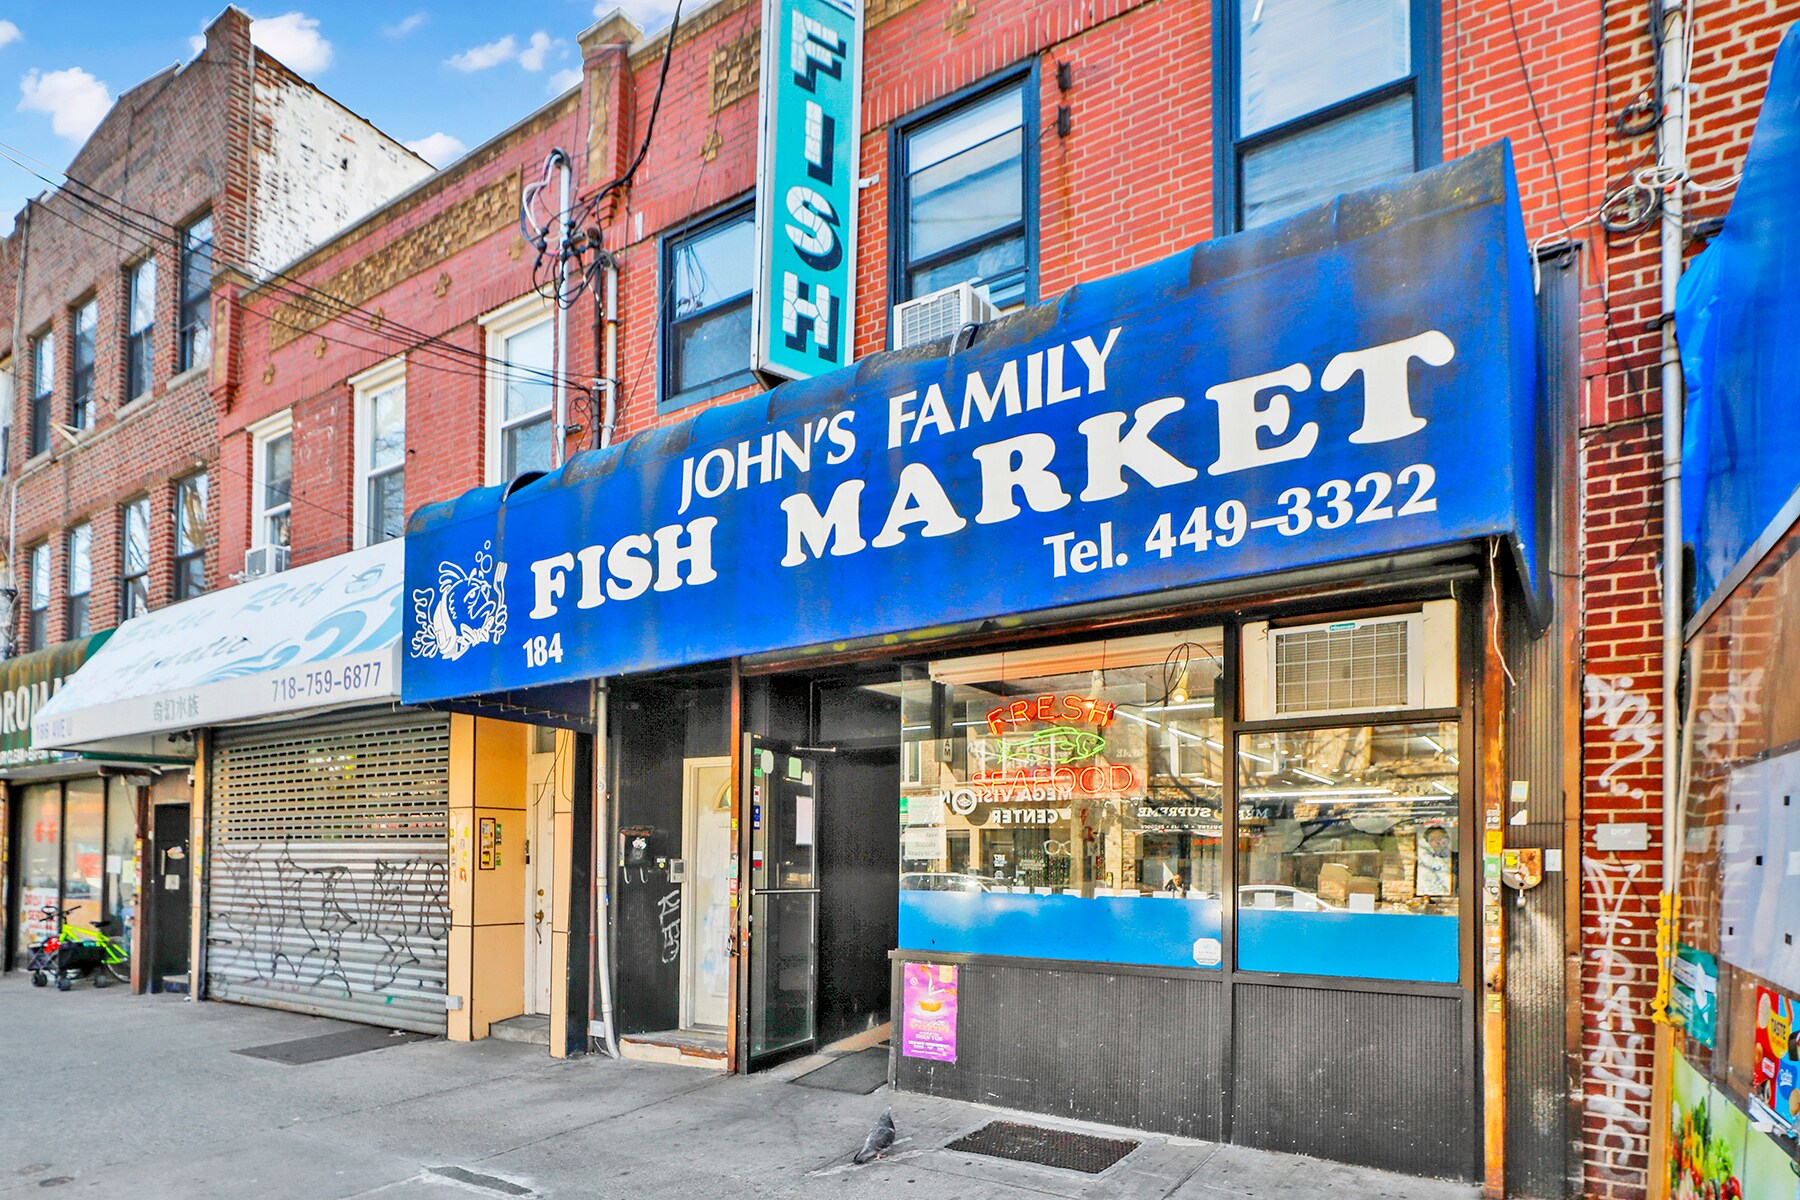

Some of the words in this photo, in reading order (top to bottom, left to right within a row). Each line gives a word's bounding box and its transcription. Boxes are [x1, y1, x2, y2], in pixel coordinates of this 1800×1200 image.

[781, 6, 845, 362] FISH
[678, 410, 855, 515] JOHN'S
[888, 326, 1122, 449] FAMILY
[529, 516, 717, 620] FISH
[780, 330, 1455, 568] MARKET
[1044, 521, 1128, 578] Tel.
[522, 632, 563, 669] 184
[272, 662, 382, 703] 718-759-6877
[986, 695, 1114, 735] FRESH
[971, 765, 1133, 797] SEAFOOD
